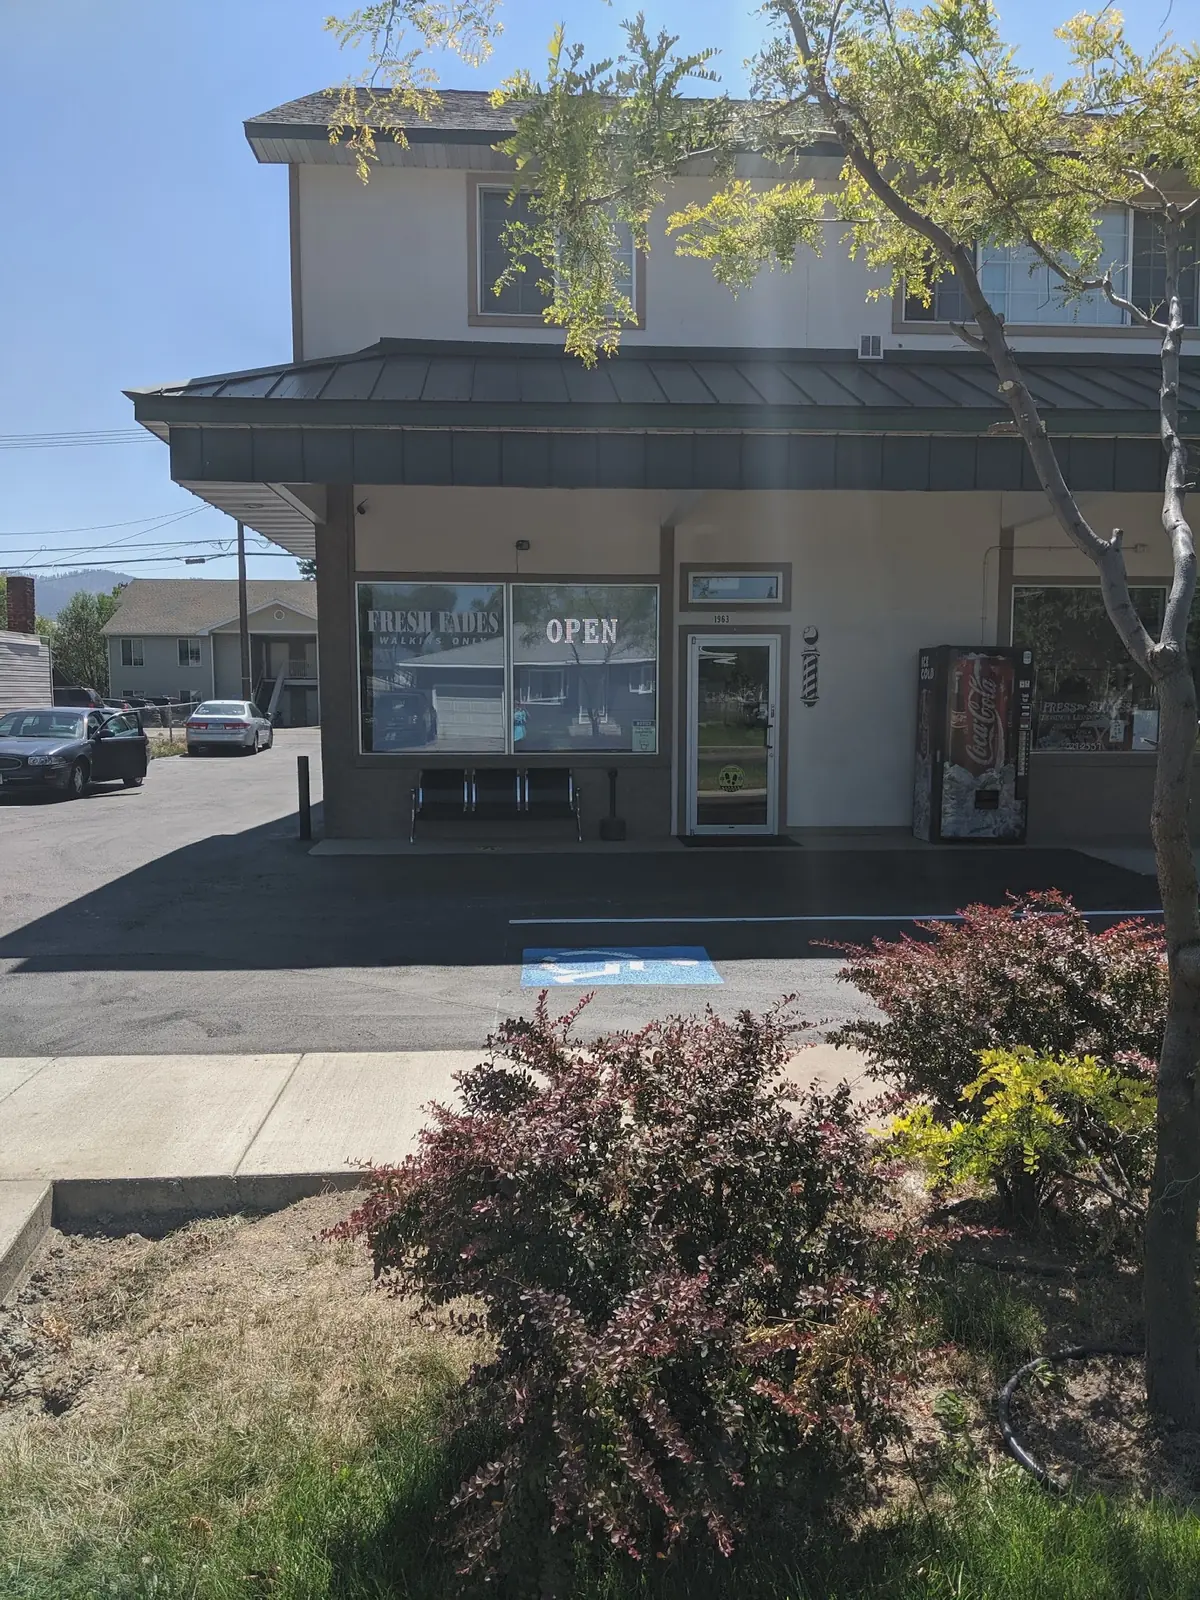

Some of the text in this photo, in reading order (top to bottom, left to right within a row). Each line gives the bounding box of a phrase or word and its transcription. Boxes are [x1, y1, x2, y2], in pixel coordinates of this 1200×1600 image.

[367, 610, 500, 634] FRESH FADES
[546, 617, 618, 645] OPEN
[451, 636, 488, 646] ONLY
[920, 667, 935, 680] COLD
[1042, 701, 1077, 713] PRESS
